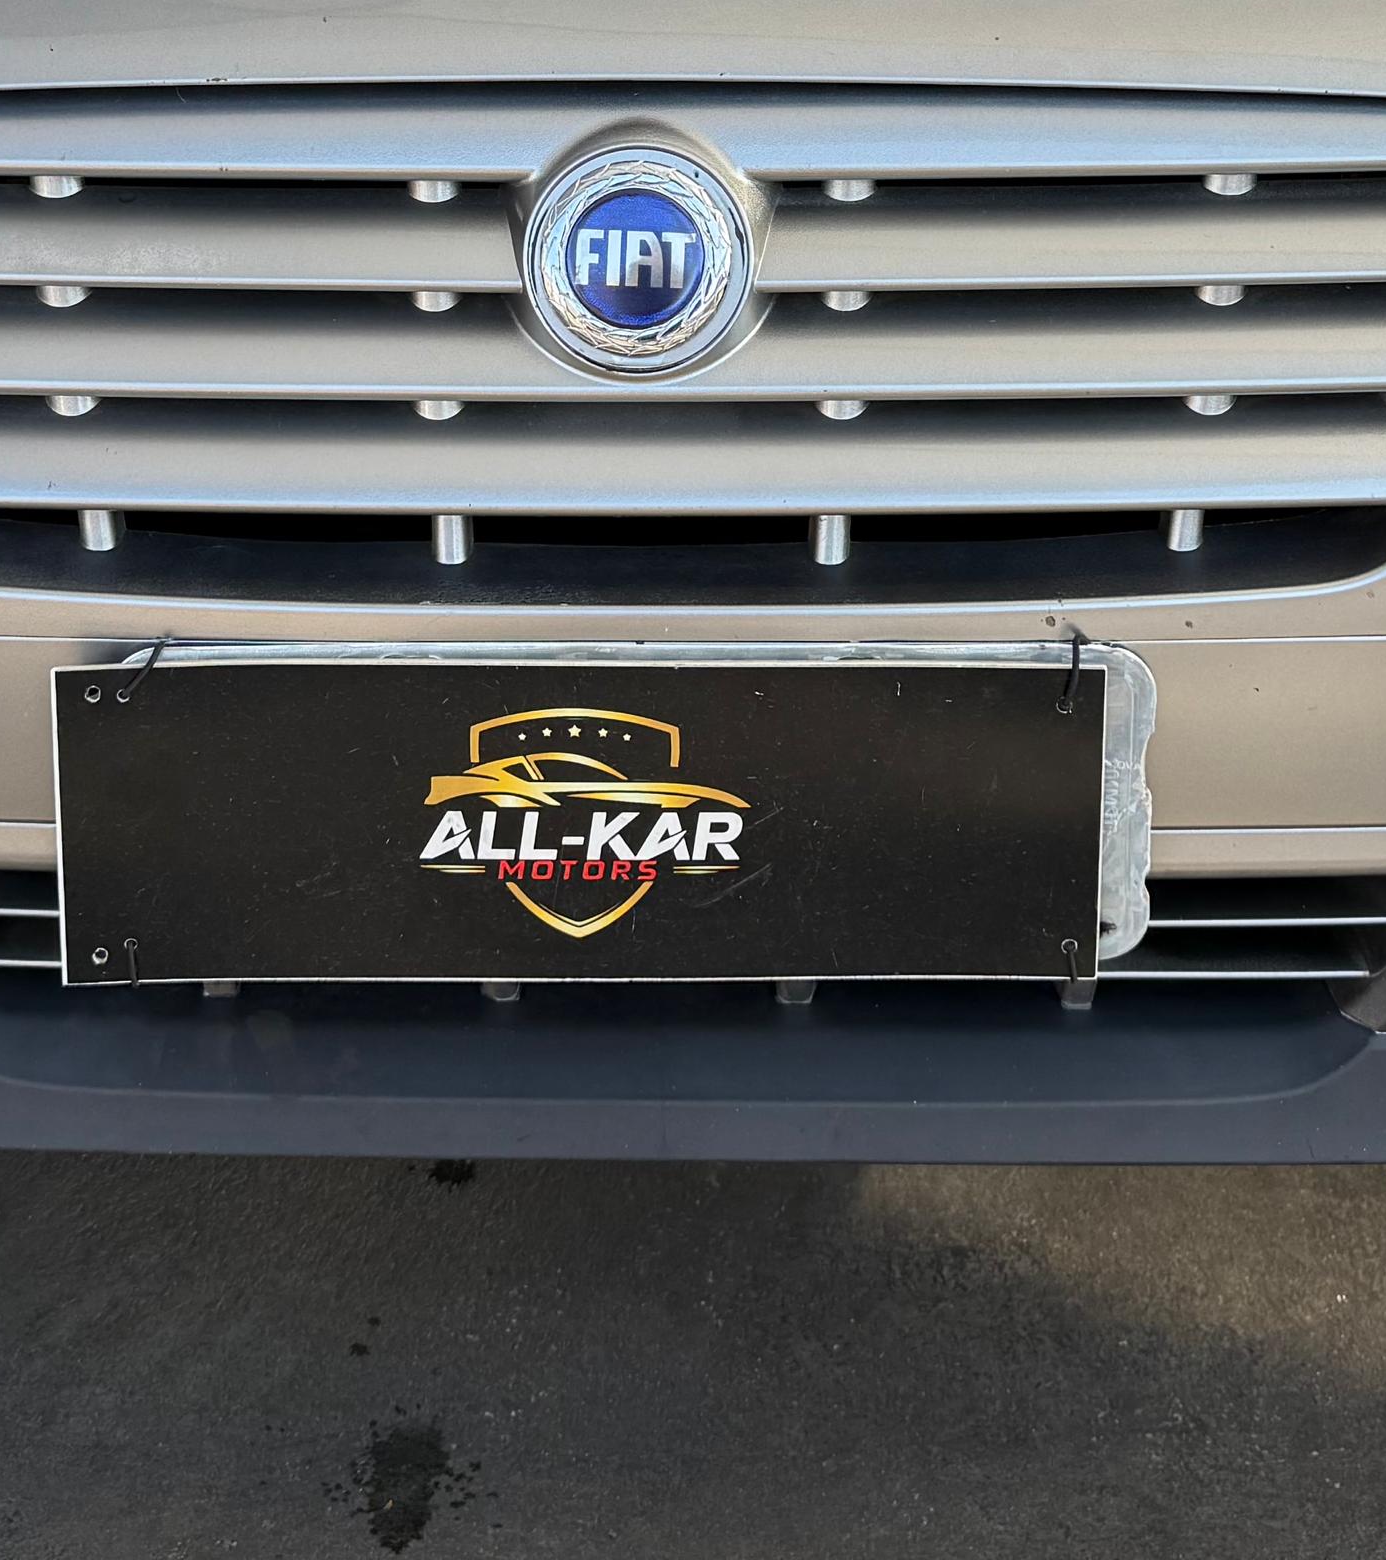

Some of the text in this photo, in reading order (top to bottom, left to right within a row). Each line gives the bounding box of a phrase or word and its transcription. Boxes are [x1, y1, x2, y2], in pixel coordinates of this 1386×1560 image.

[574, 228, 696, 289] FIAT
[419, 810, 744, 861] ALL-KAR
[498, 860, 658, 881] MOTORS
